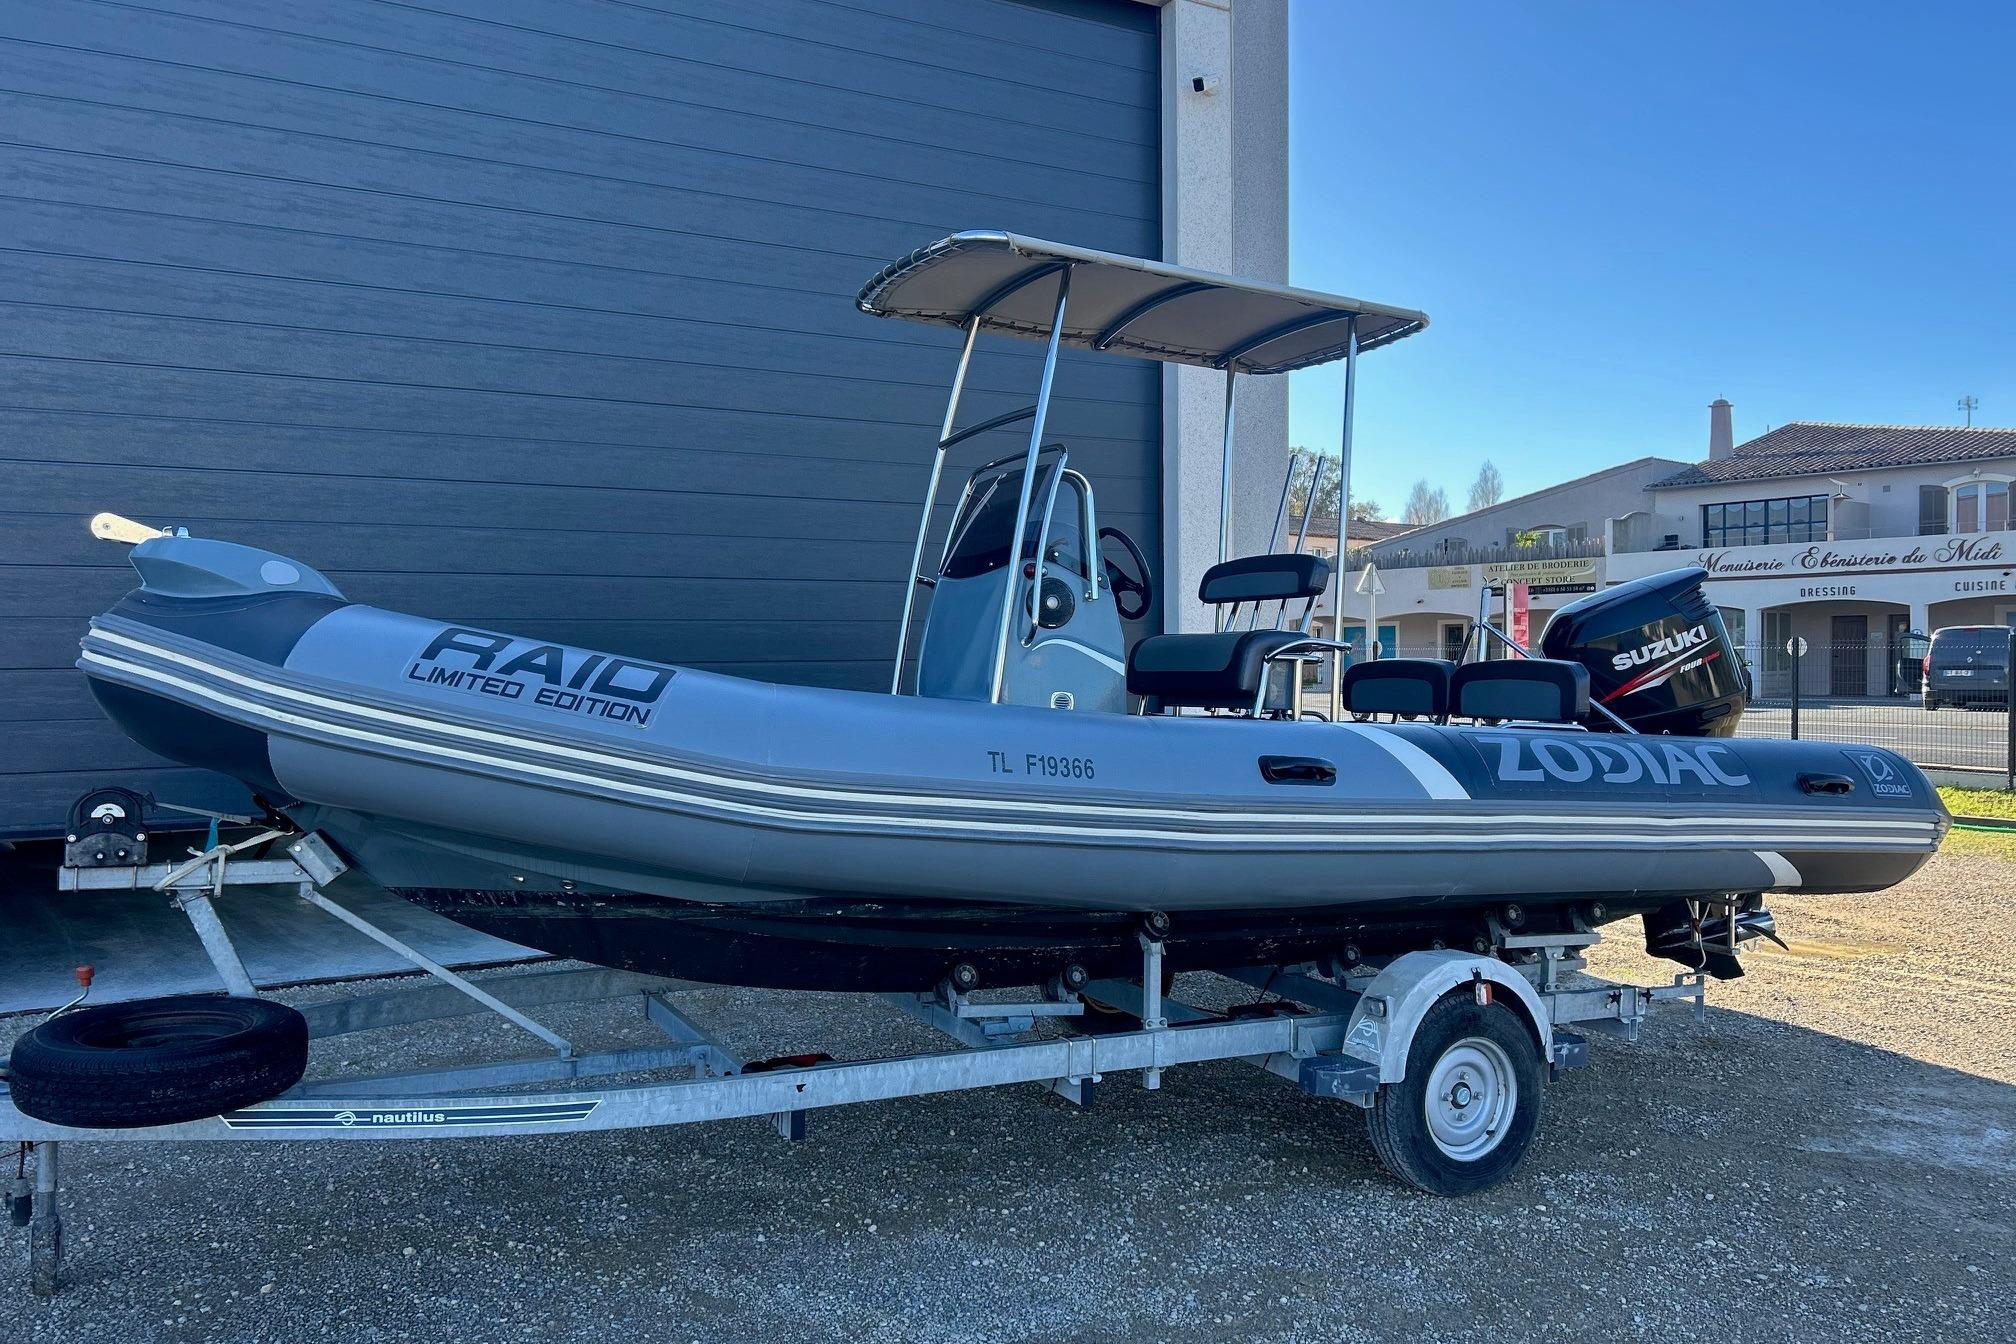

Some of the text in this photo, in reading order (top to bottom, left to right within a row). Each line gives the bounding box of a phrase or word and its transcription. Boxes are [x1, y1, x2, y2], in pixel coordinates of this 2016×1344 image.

[1688, 551, 1784, 573] Menuiserie
[1902, 547, 1927, 564] du
[1934, 537, 2003, 562] Midi
[1488, 560, 1589, 572] ATELIER DE BRODERIE
[1545, 576, 1576, 584] STORE
[1955, 581, 2006, 592] CUISINE
[1800, 586, 1856, 597] DRESSING
[1612, 624, 1708, 671] SUZUKI
[419, 627, 678, 704] RAID
[1680, 657, 1703, 674] FOUR
[408, 662, 652, 725] LIMITED EDITION
[987, 750, 1095, 780] TL F19366
[1475, 735, 1751, 787] ZODIAC
[1873, 783, 1910, 794] ZODIAC
[372, 1111, 446, 1124] nautilus
